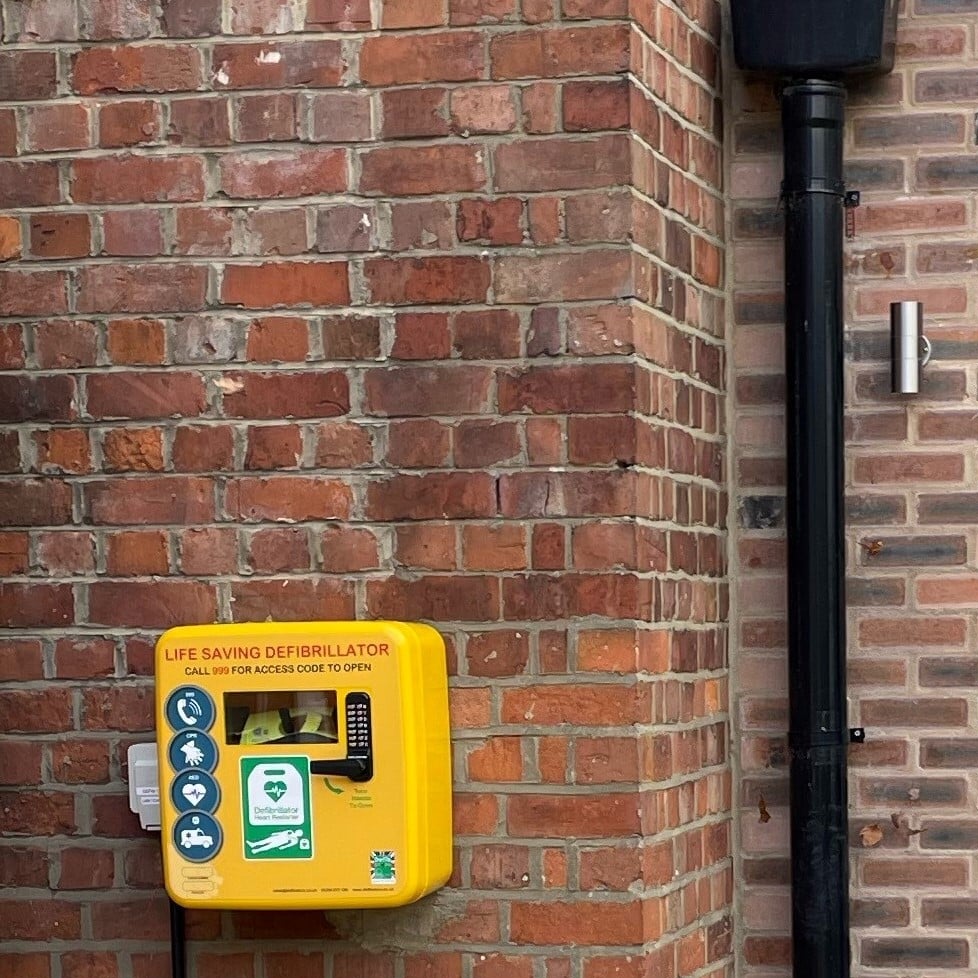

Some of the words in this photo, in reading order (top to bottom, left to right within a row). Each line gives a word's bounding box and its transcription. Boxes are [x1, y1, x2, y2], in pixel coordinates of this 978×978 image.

[165, 648, 198, 661] LIFE
[201, 646, 261, 660] SAVING
[265, 643, 390, 659] DEFIBRILLATOR
[184, 666, 210, 676] CALL
[212, 666, 230, 675] 999
[231, 665, 252, 675] FOR
[254, 664, 294, 675] ACCESS
[296, 663, 326, 674] CODE
[327, 663, 341, 673] TO
[343, 662, 372, 672] OPEN
